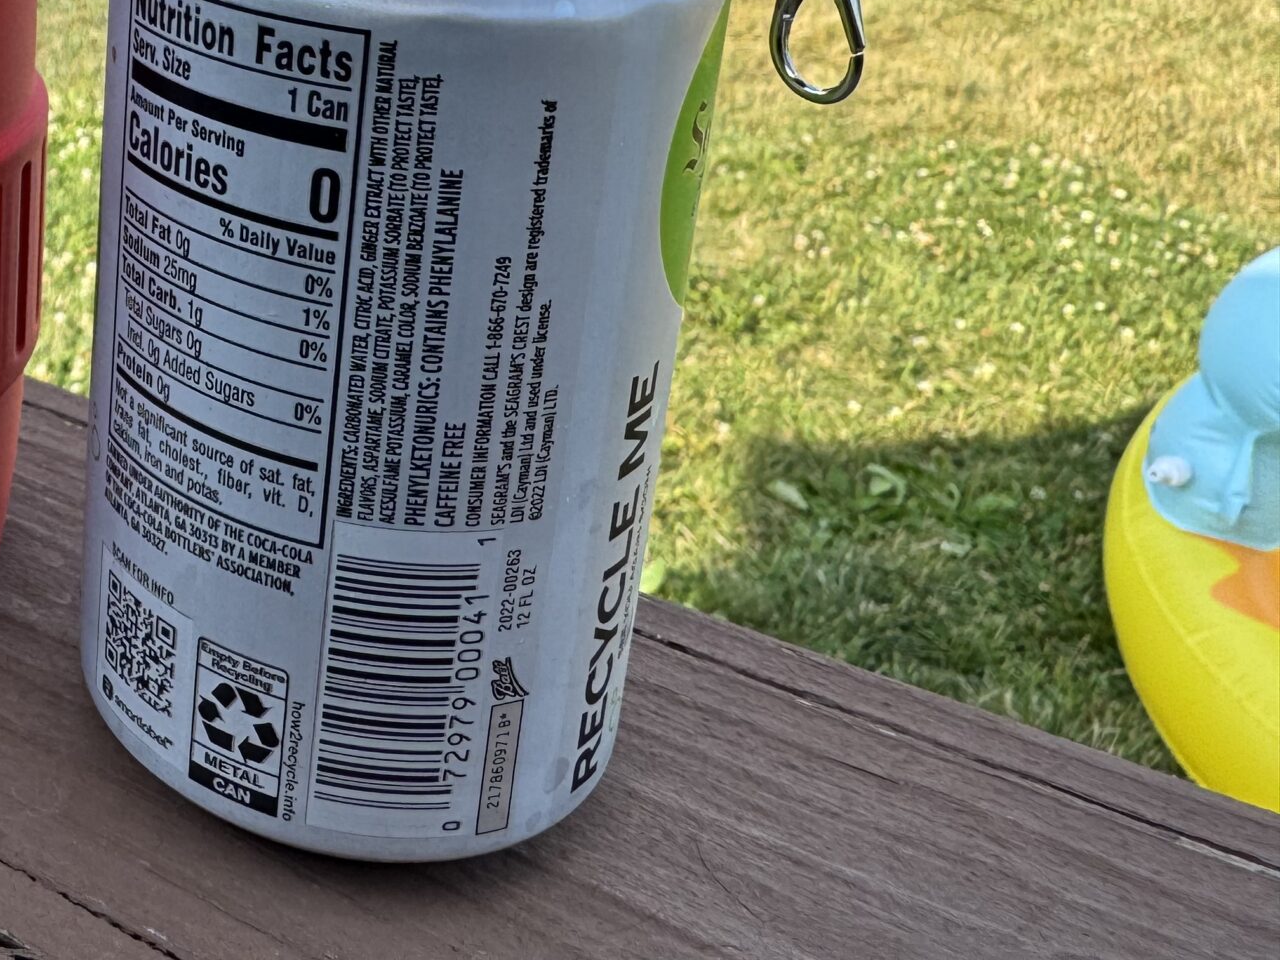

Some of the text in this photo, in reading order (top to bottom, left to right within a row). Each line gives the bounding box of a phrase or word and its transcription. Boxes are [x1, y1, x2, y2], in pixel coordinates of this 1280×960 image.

[133, 28, 348, 122] Serv. Size 1 Can
[255, 23, 352, 82] Facts
[131, 85, 245, 157] Amount Per Serving
[541, 100, 557, 113] of
[129, 111, 341, 223] Calories 0
[392, 120, 413, 171] PROTECT
[415, 120, 437, 171] PROTECT
[534, 116, 556, 186] trademarks
[388, 172, 409, 192] (TO
[411, 171, 432, 192] (TO
[125, 195, 333, 299] Total Fat 0g 0%
[220, 218, 336, 265] % Daily Value
[385, 193, 405, 245] SORBATE
[407, 193, 428, 250] BENZOATE
[527, 189, 546, 250] registered
[124, 225, 330, 330] Sodium 25mg 1%
[336, 40, 398, 518] INGREDIENTS: CARBONATED WATER, CITRIC ACID, GINGER EXTRACT WITH OTHER NATURAL
[377, 245, 400, 311] POTASSIUM
[402, 249, 422, 298] SODIUM
[525, 252, 538, 270] are
[122, 254, 327, 363] Total Carb. 1g 0%
[519, 272, 539, 312] design
[533, 299, 552, 343] license.
[125, 286, 202, 358] Total Sugars 0g
[373, 312, 396, 360] CITRATE,
[404, 168, 464, 526] PHENYLKETONURICS: CONTAINS PHENYLALANINE
[513, 315, 530, 351] CREST
[118, 341, 170, 402] Protein 0g
[127, 320, 321, 425] Incl. 0g Added Sugars 0%
[369, 361, 390, 405] SODIUM
[392, 340, 413, 391] CARAMEL
[466, 256, 512, 527] CONSUMER INFORMATION CALL 1-866-670-7249
[530, 346, 546, 379] under
[524, 411, 537, 430] and
[527, 381, 541, 407] used
[363, 406, 386, 471] ASPARTAME,
[387, 392, 411, 456] POTASSIUM,
[502, 439, 514, 462] and
[503, 420, 517, 438] the
[521, 433, 534, 449] Ltd
[138, 422, 152, 447] fat,
[159, 442, 208, 481] cholest.,
[218, 468, 252, 499] fiber,
[263, 488, 285, 507] vit.
[144, 450, 163, 473] iron
[165, 463, 183, 486] and
[192, 438, 234, 468] source
[240, 460, 254, 476] of
[293, 474, 315, 497] fat,
[379, 456, 401, 524] ACESULFAME
[435, 421, 467, 527] CAFFEINE FREE
[131, 516, 141, 533] GA
[155, 481, 204, 525] AUTHORITY
[208, 518, 221, 531] OF
[225, 523, 244, 544] THE
[247, 533, 313, 564] COCA-COLA
[358, 474, 380, 521] FLAVORS,
[135, 488, 171, 526] ATLANTA,
[175, 517, 187, 533] GA
[189, 523, 218, 549] 30313
[221, 543, 236, 559] BY
[238, 549, 245, 561] A
[248, 551, 300, 578] MEMBER
[132, 562, 150, 589] FOR
[152, 578, 174, 605] INFO
[498, 549, 521, 632] 2022-00263
[517, 566, 537, 628] 12 FL OZ
[571, 485, 640, 794] RECYCLE
[618, 360, 659, 480] ME
[243, 660, 285, 685] Before
[442, 537, 496, 831] 0 72979 00041 1
[205, 752, 264, 788] METAL
[283, 701, 305, 822] how2recycle.info
[213, 778, 251, 804] CAN
